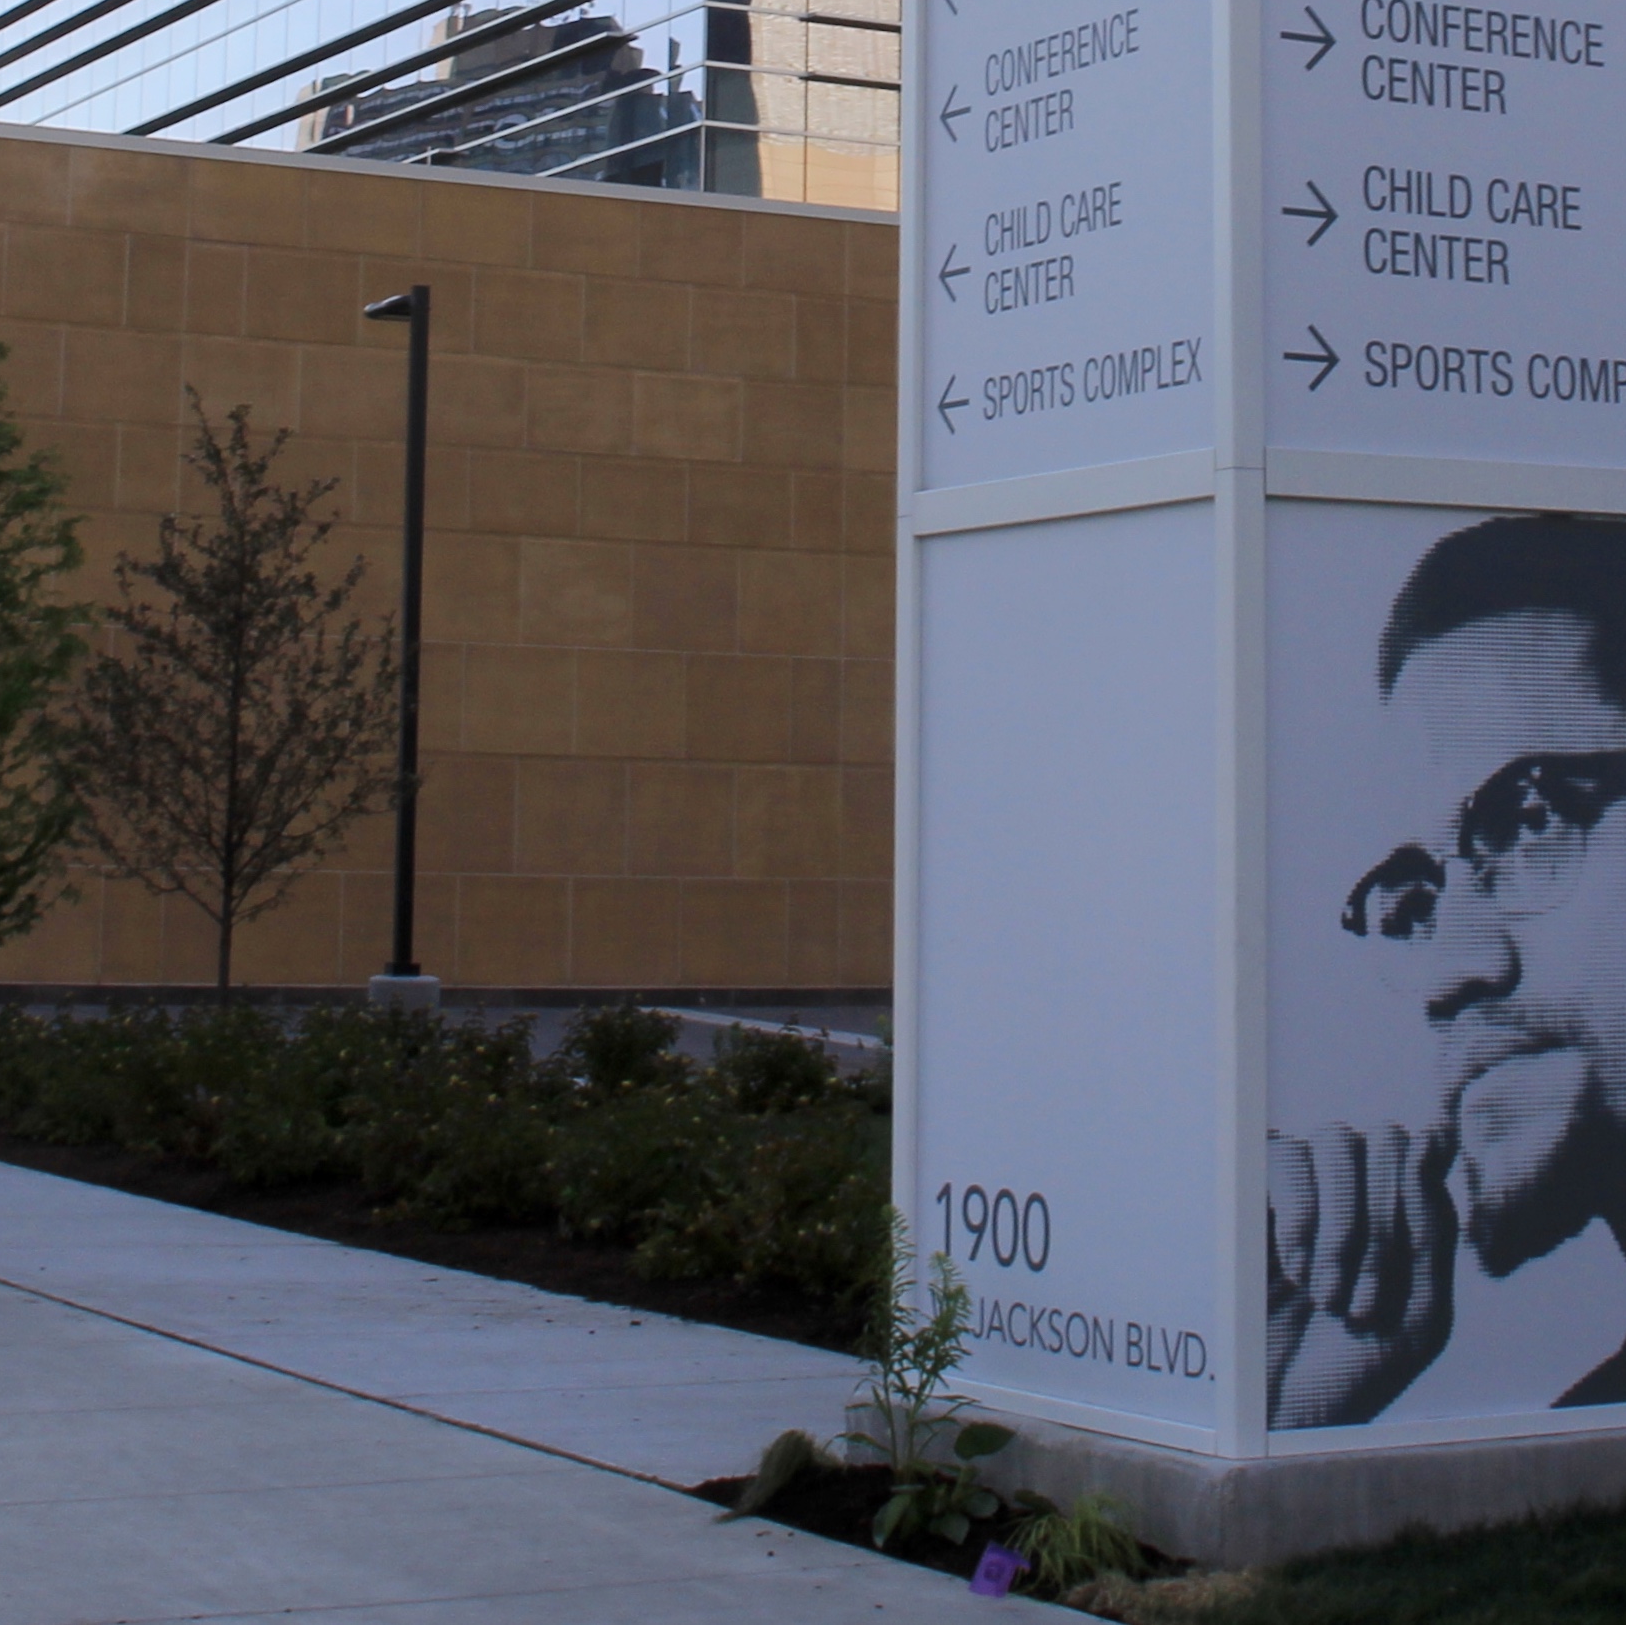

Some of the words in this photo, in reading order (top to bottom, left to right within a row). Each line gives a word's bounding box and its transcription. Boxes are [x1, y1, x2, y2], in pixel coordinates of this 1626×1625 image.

[985, 7, 1140, 96] CONFERENCE
[1361, 54, 1507, 115] CENTER
[984, 88, 1074, 154] CENTER
[984, 200, 1052, 257] CHILD
[1060, 181, 1123, 239] CARE
[1362, 164, 1473, 220] CHILD
[1486, 178, 1583, 231] CARE
[984, 254, 1075, 315] CENTER
[1363, 227, 1510, 286] CENTER
[982, 362, 1075, 421] SPORTS
[1083, 336, 1203, 403] COMPLEX
[1364, 340, 1514, 397] SPORTS
[935, 1183, 1051, 1273] 1900
[971, 1296, 1115, 1363] JACKSON
[1125, 1321, 1216, 1382] BLVD.
